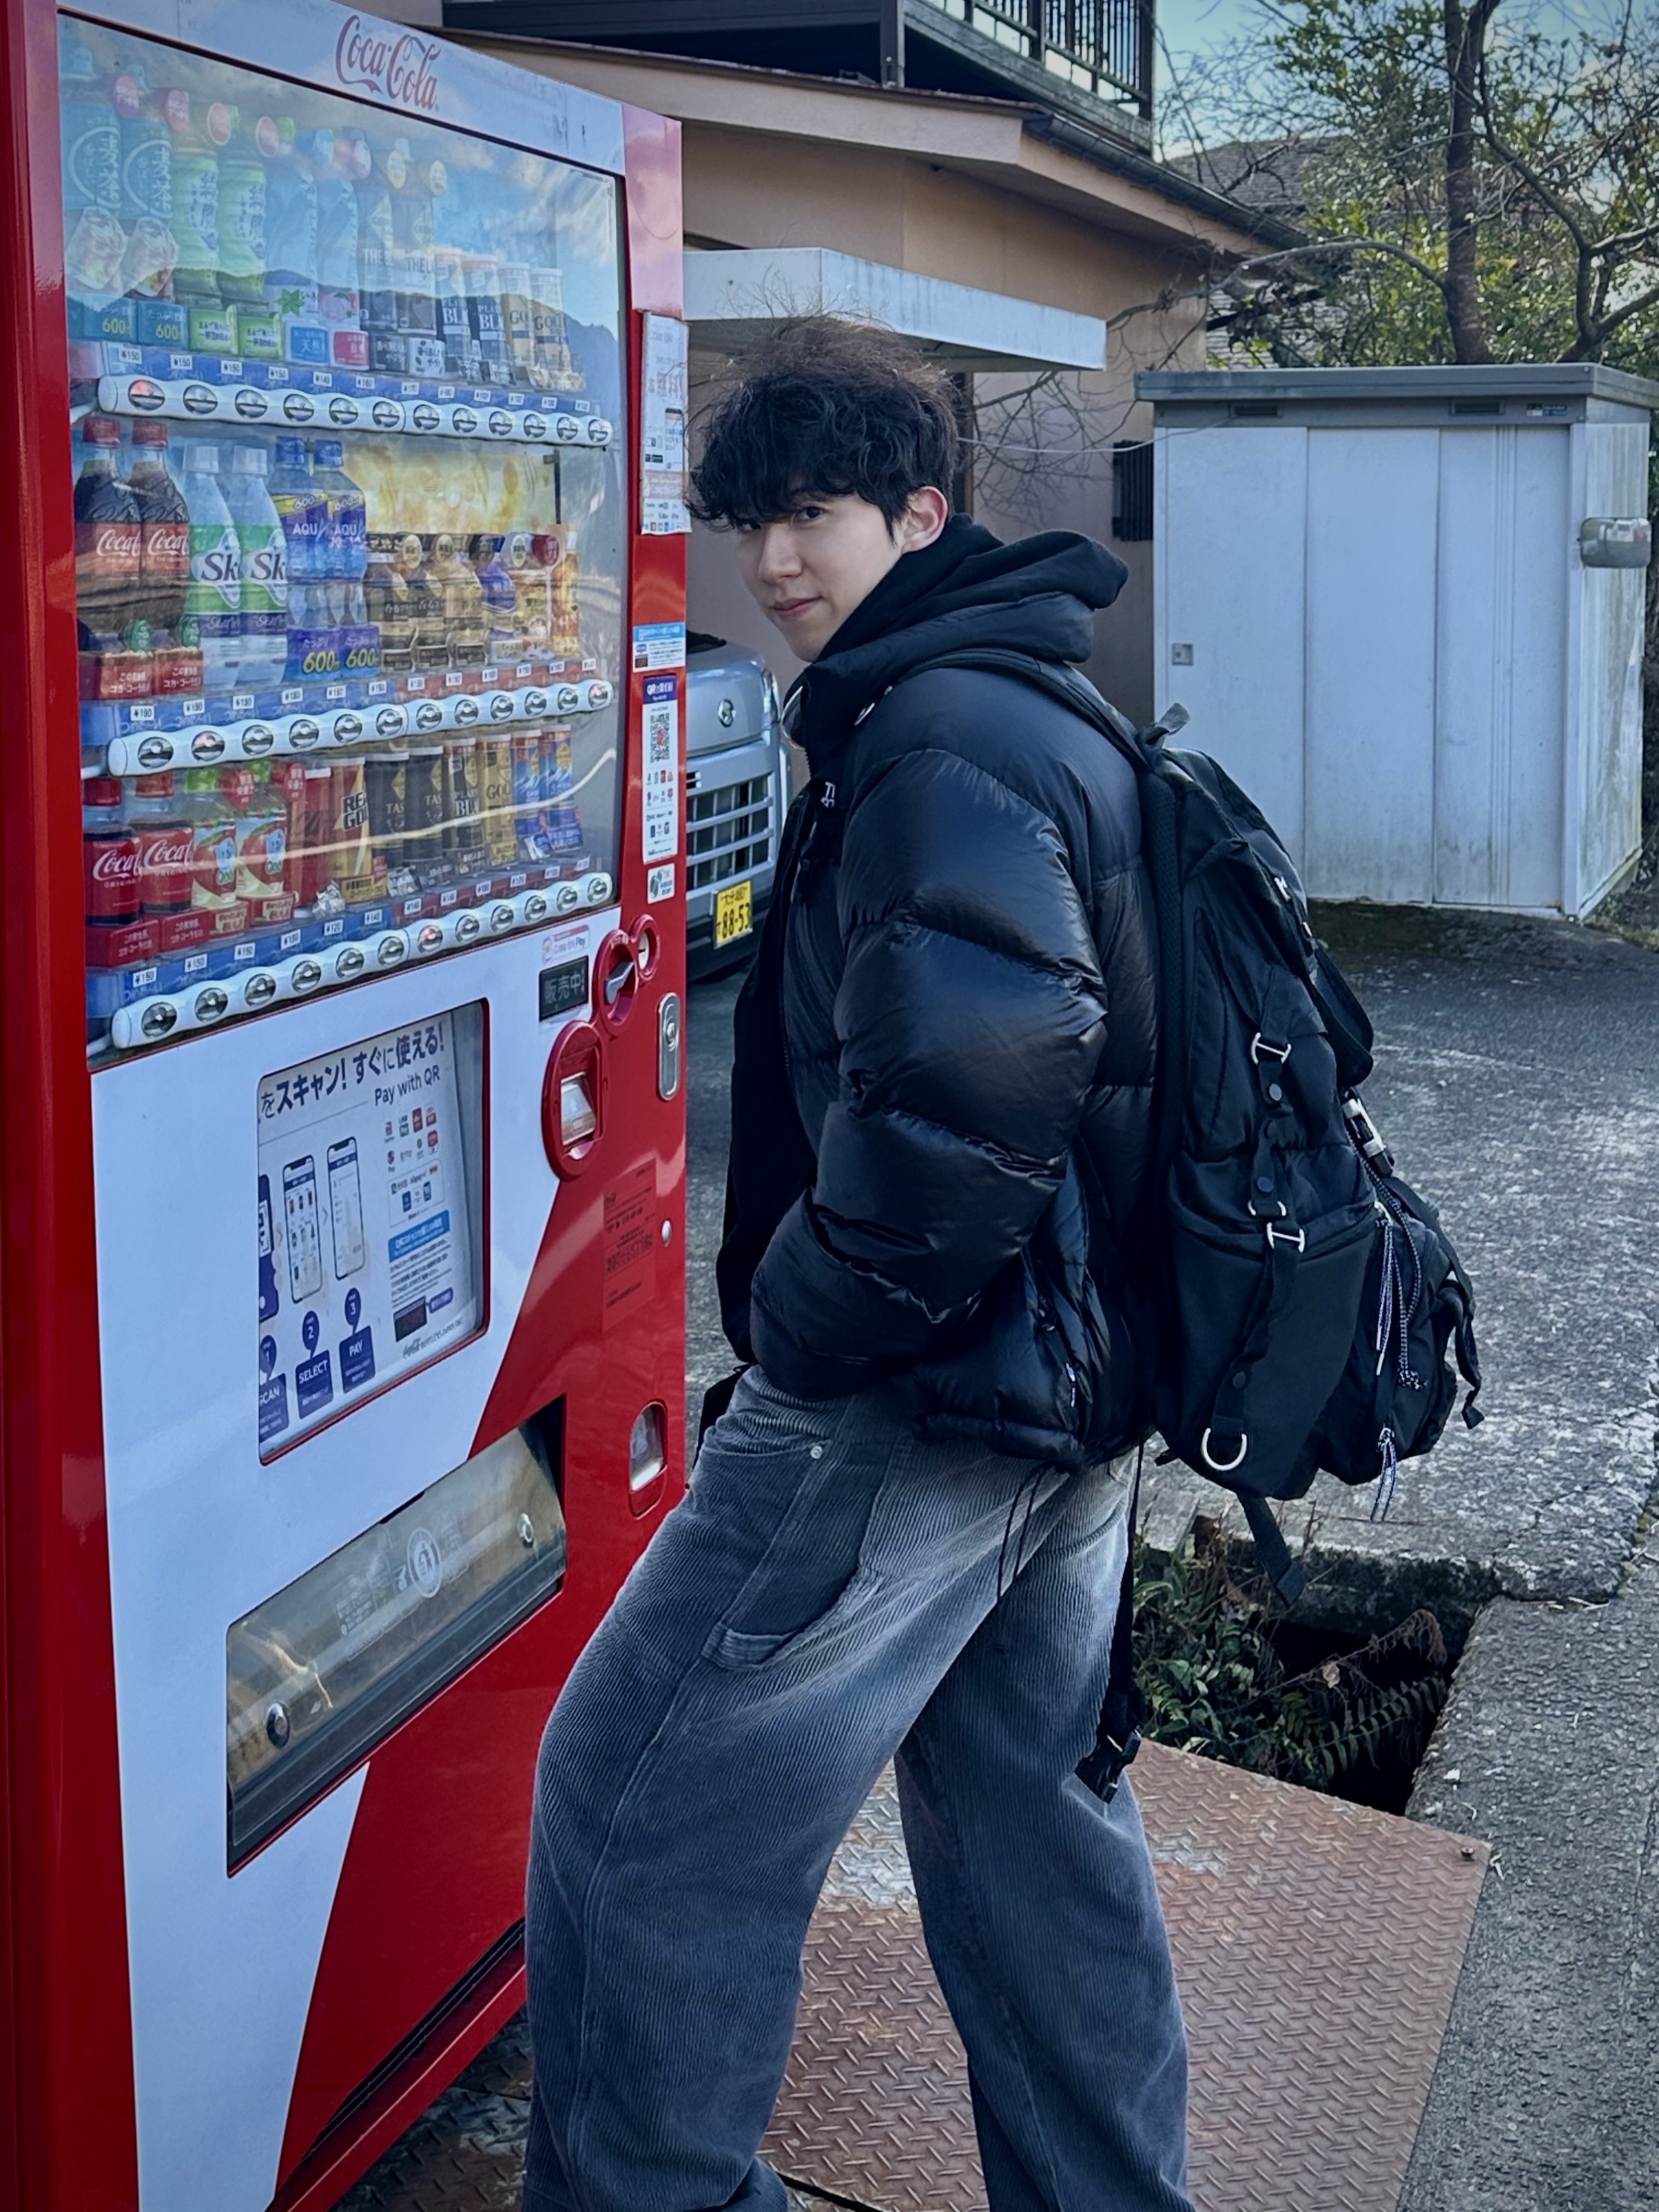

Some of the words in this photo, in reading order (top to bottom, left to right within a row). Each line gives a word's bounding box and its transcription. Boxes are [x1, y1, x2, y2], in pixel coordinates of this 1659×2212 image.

[336, 14, 442, 110] Coca-Cola
[544, 972, 582, 1004] 販売中
[375, 1086, 395, 1106] Pay
[398, 1073, 422, 1097] with
[424, 1065, 441, 1086] QR
[350, 1302, 356, 1315] 3
[307, 1327, 314, 1340] 2
[349, 1340, 363, 1358] PAY
[298, 1360, 328, 1384] SELECT
